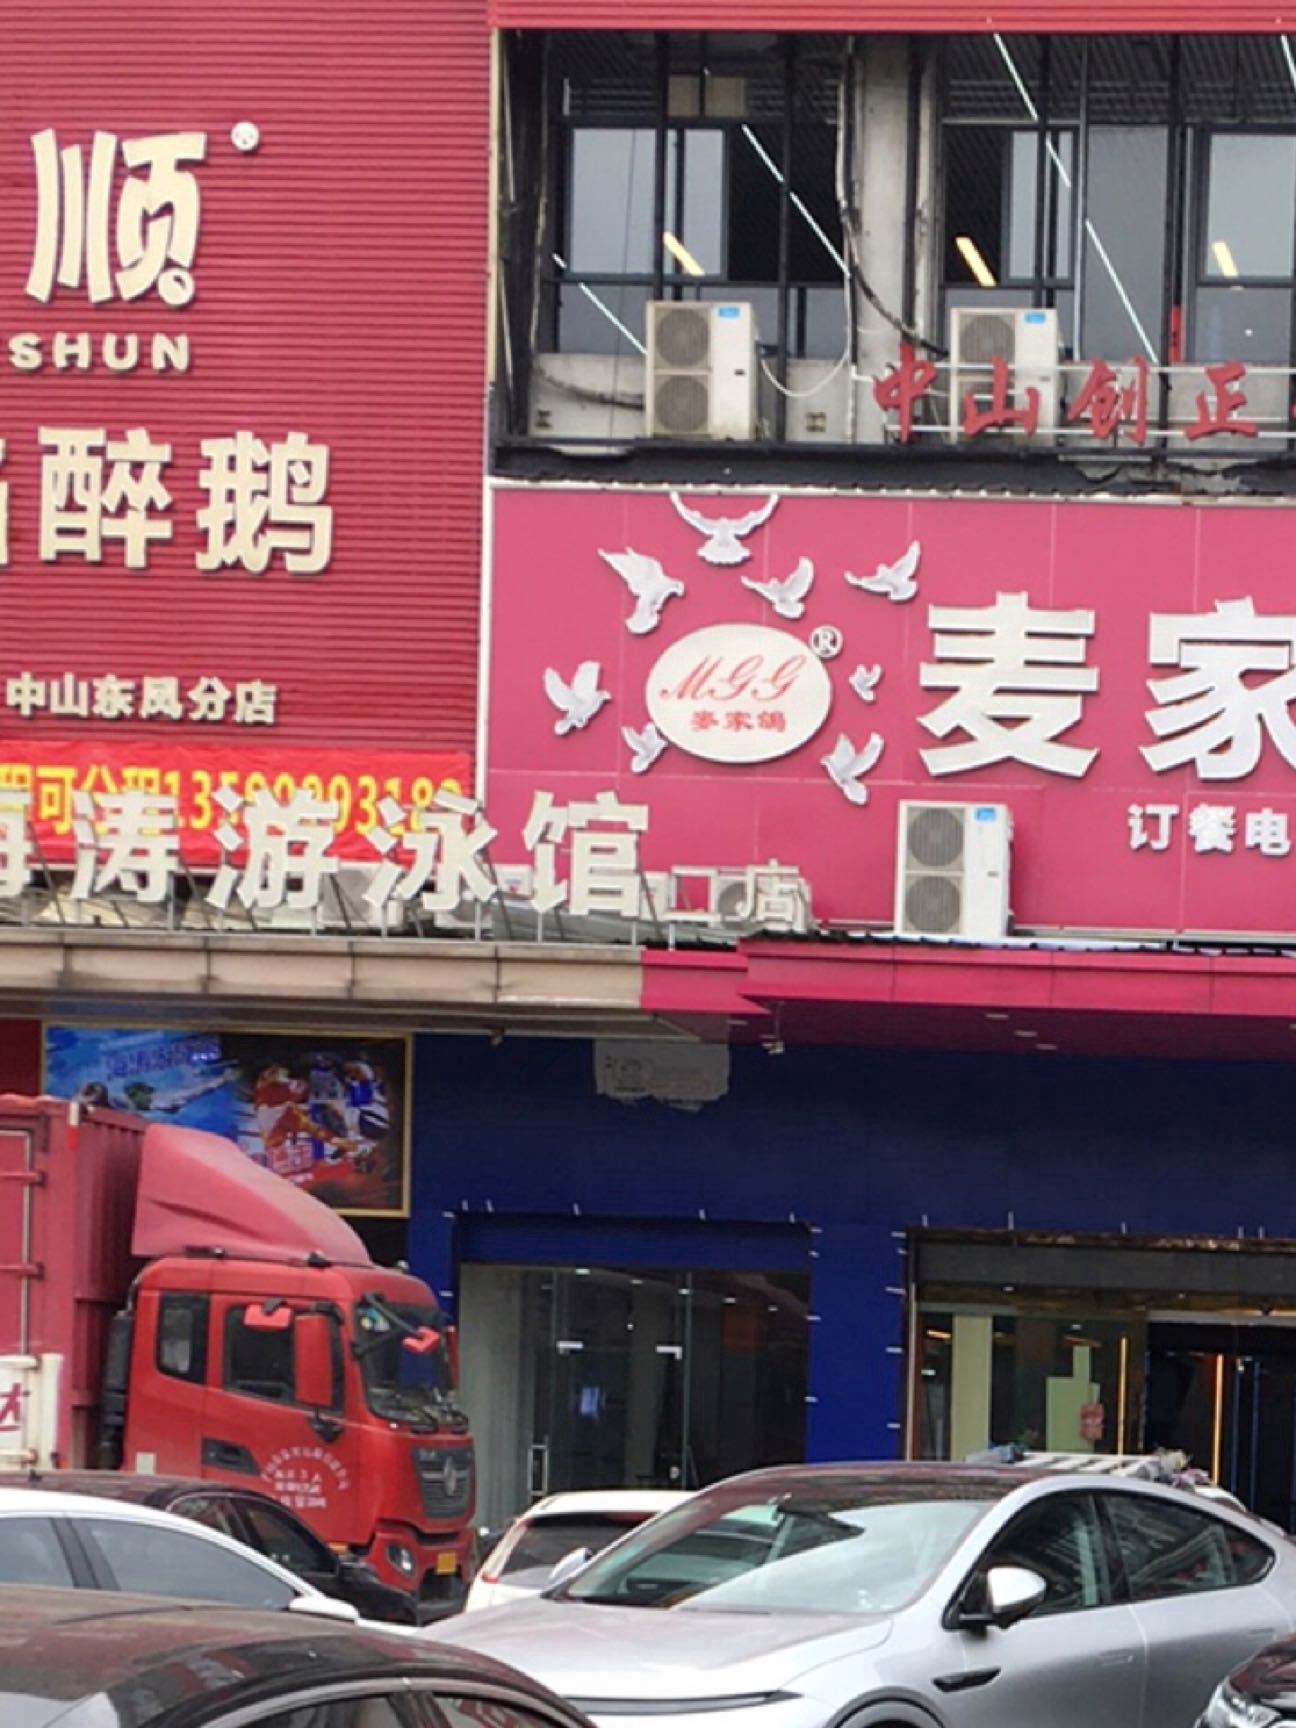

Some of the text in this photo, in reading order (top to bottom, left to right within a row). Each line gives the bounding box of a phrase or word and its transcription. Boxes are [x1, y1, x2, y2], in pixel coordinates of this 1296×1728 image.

[24, 127, 208, 308] 顺
[8, 332, 191, 373] SHUN
[0, 425, 334, 576] 醉鹅
